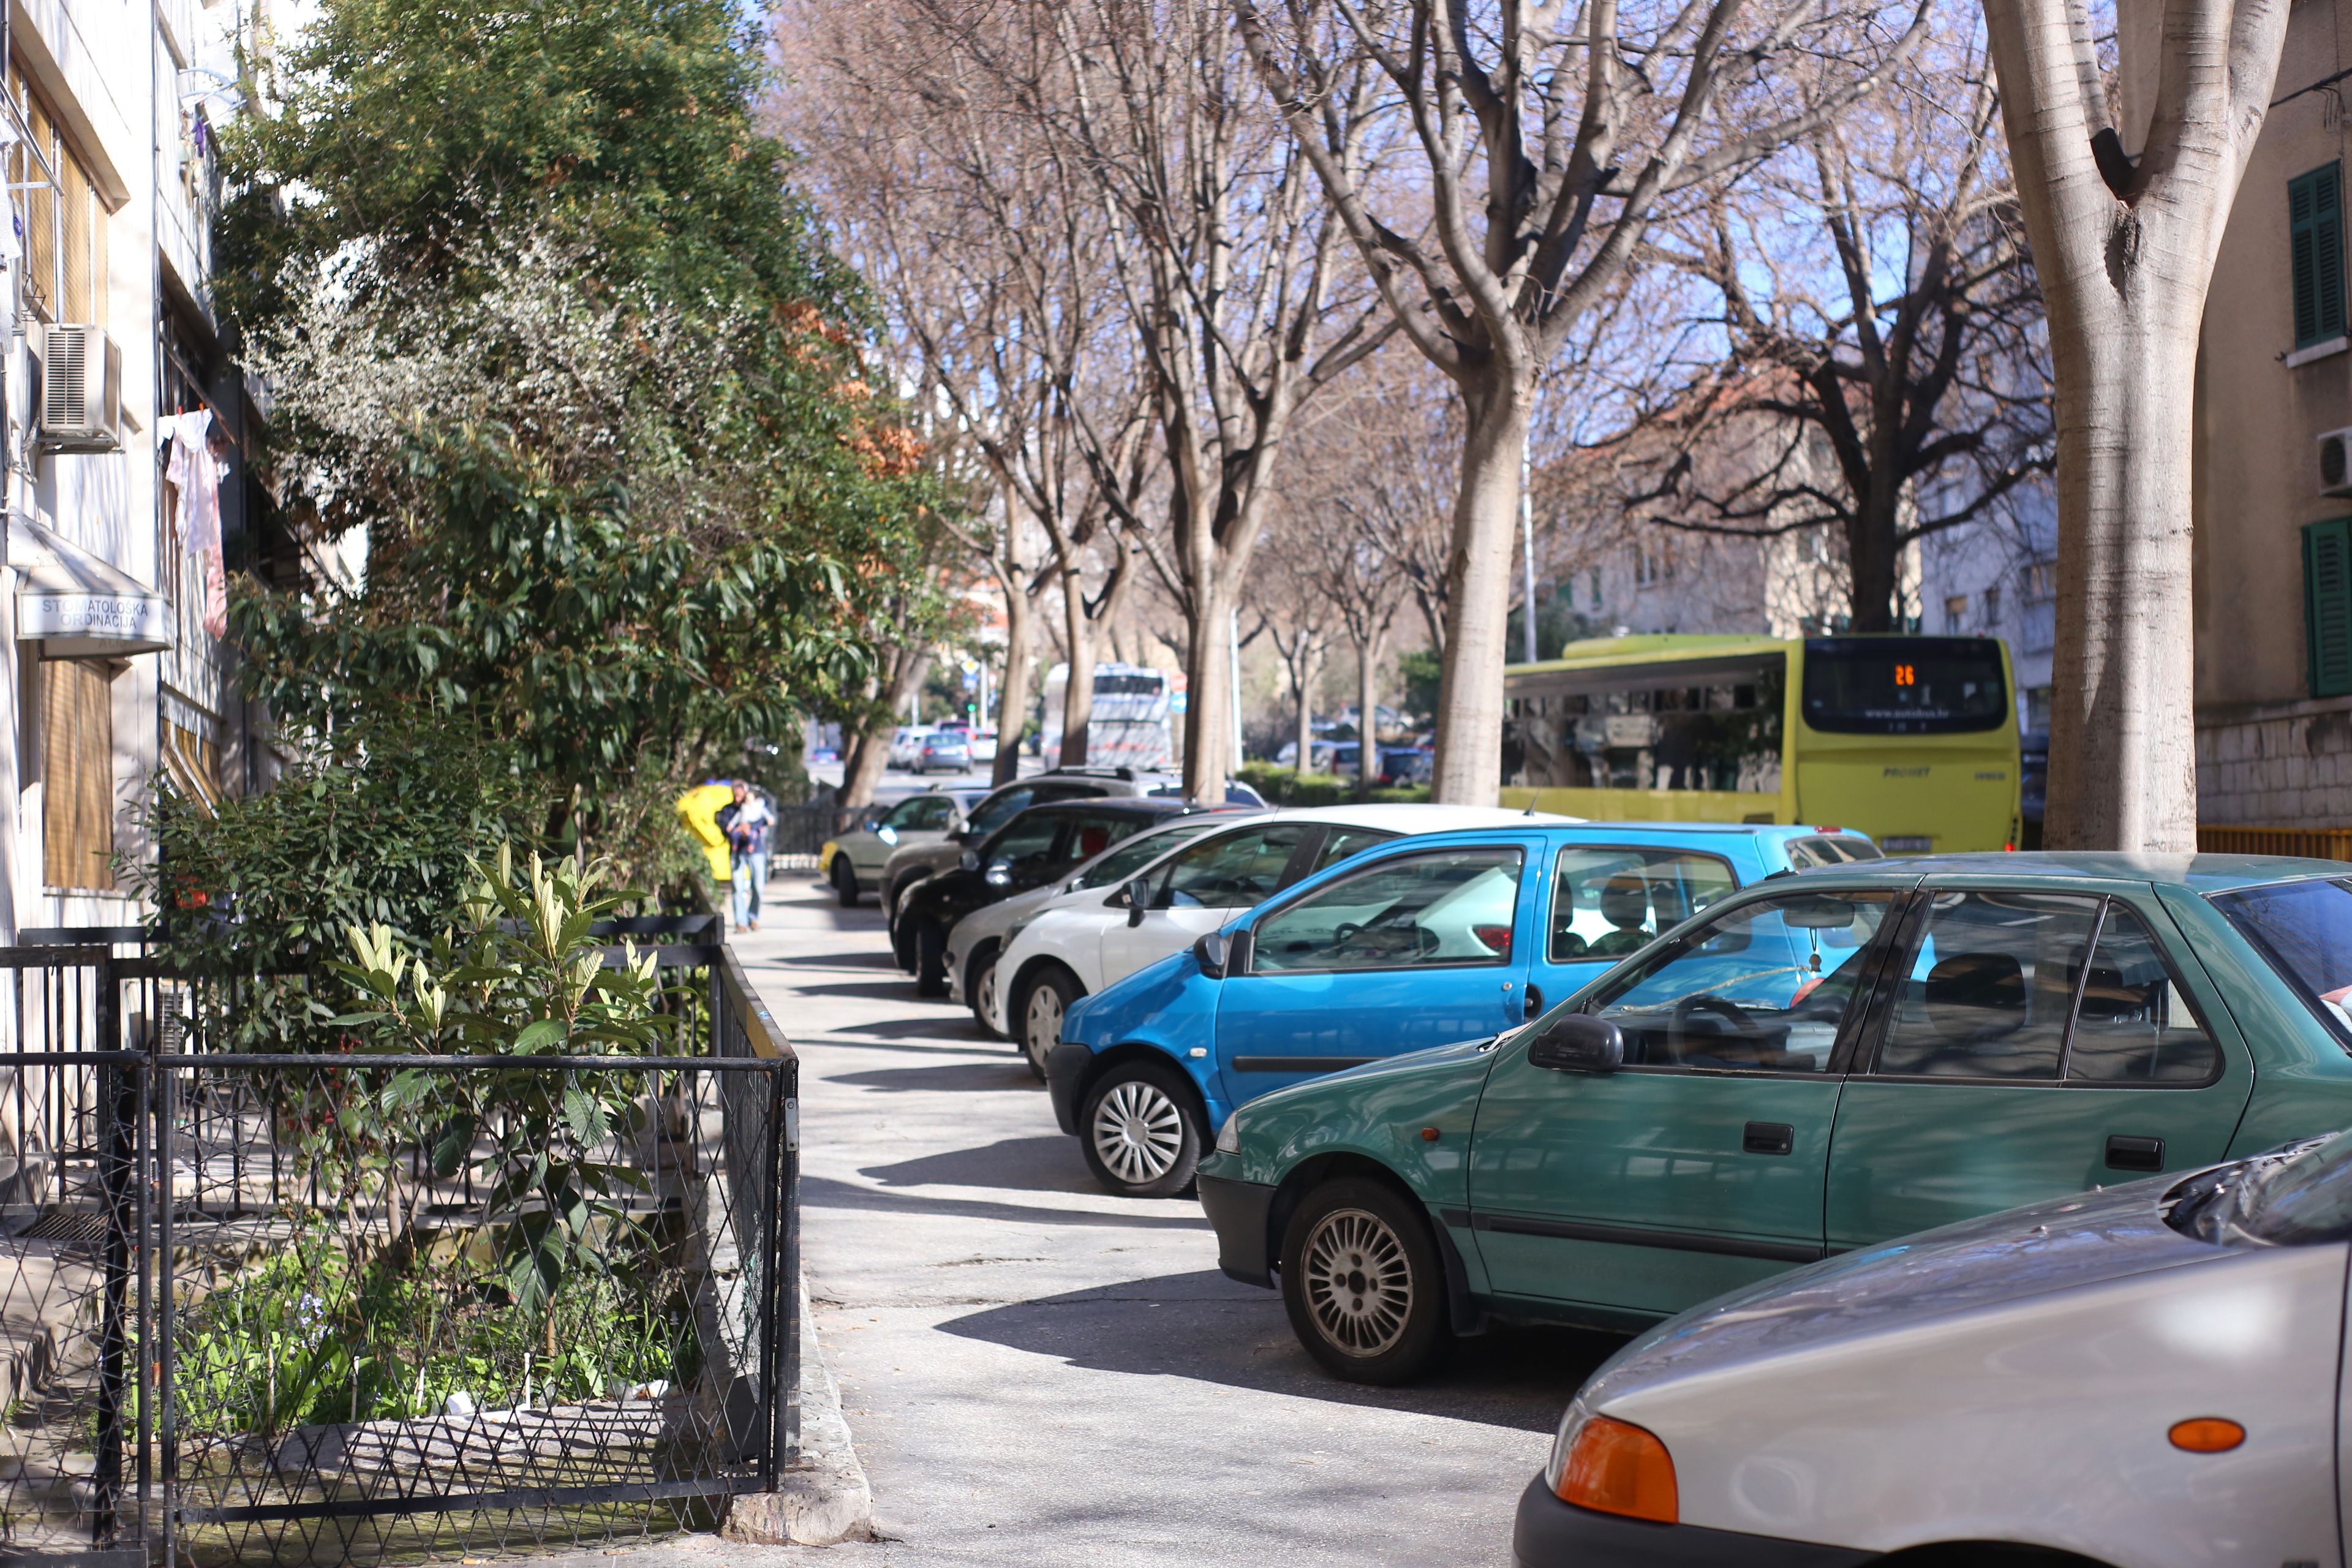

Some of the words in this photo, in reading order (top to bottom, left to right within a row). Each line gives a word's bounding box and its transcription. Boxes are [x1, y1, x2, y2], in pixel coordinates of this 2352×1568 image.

[42, 599, 148, 616] STOMATOLOŠKA
[61, 613, 137, 629] ORDINACIJA
[1895, 665, 1915, 686] 26
